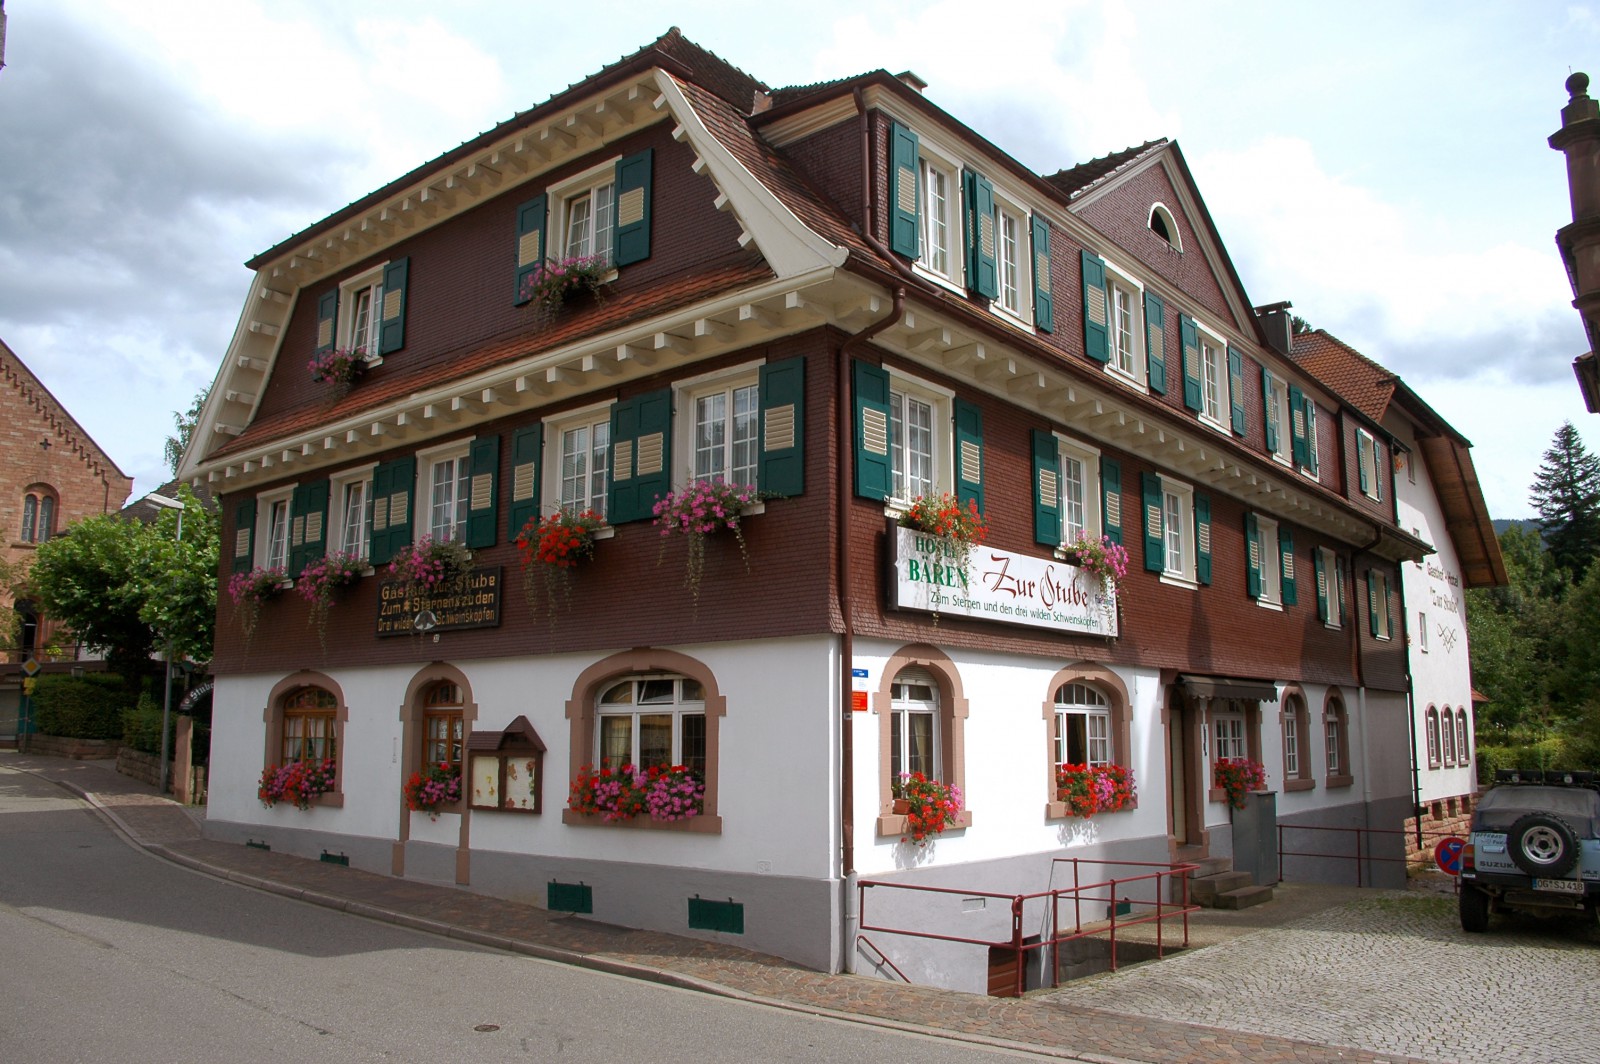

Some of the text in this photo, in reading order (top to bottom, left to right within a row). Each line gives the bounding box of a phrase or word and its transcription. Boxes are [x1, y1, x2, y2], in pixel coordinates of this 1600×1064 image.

[909, 555, 968, 591] BÄREN
[983, 553, 1088, 611] Zur Stube
[381, 601, 401, 616] Zum
[475, 590, 495, 605] den
[931, 591, 949, 605] Zum
[953, 595, 980, 610] Sternen
[984, 601, 998, 612] und
[1000, 602, 1013, 615] den
[1015, 605, 1028, 617] drei
[1030, 607, 1051, 621] wilden
[1537, 879, 1548, 888] OG
